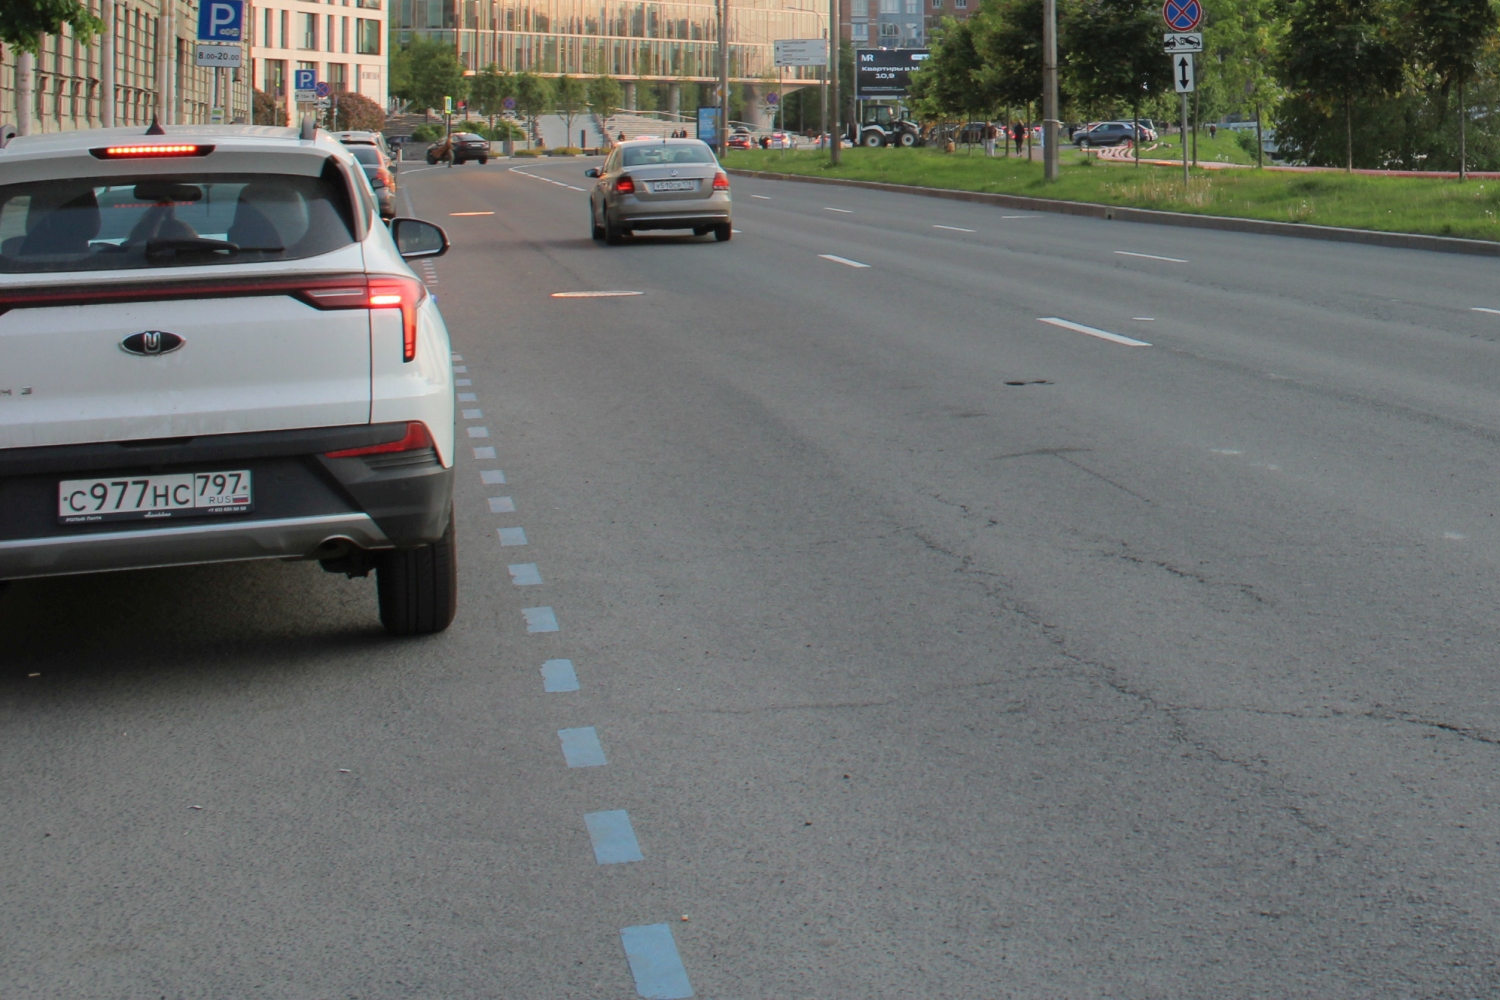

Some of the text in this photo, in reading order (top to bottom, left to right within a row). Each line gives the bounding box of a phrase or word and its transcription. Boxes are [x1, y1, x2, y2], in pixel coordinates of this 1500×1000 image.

[70, 473, 242, 512] С977НС 797
[209, 495, 231, 504] RUS
